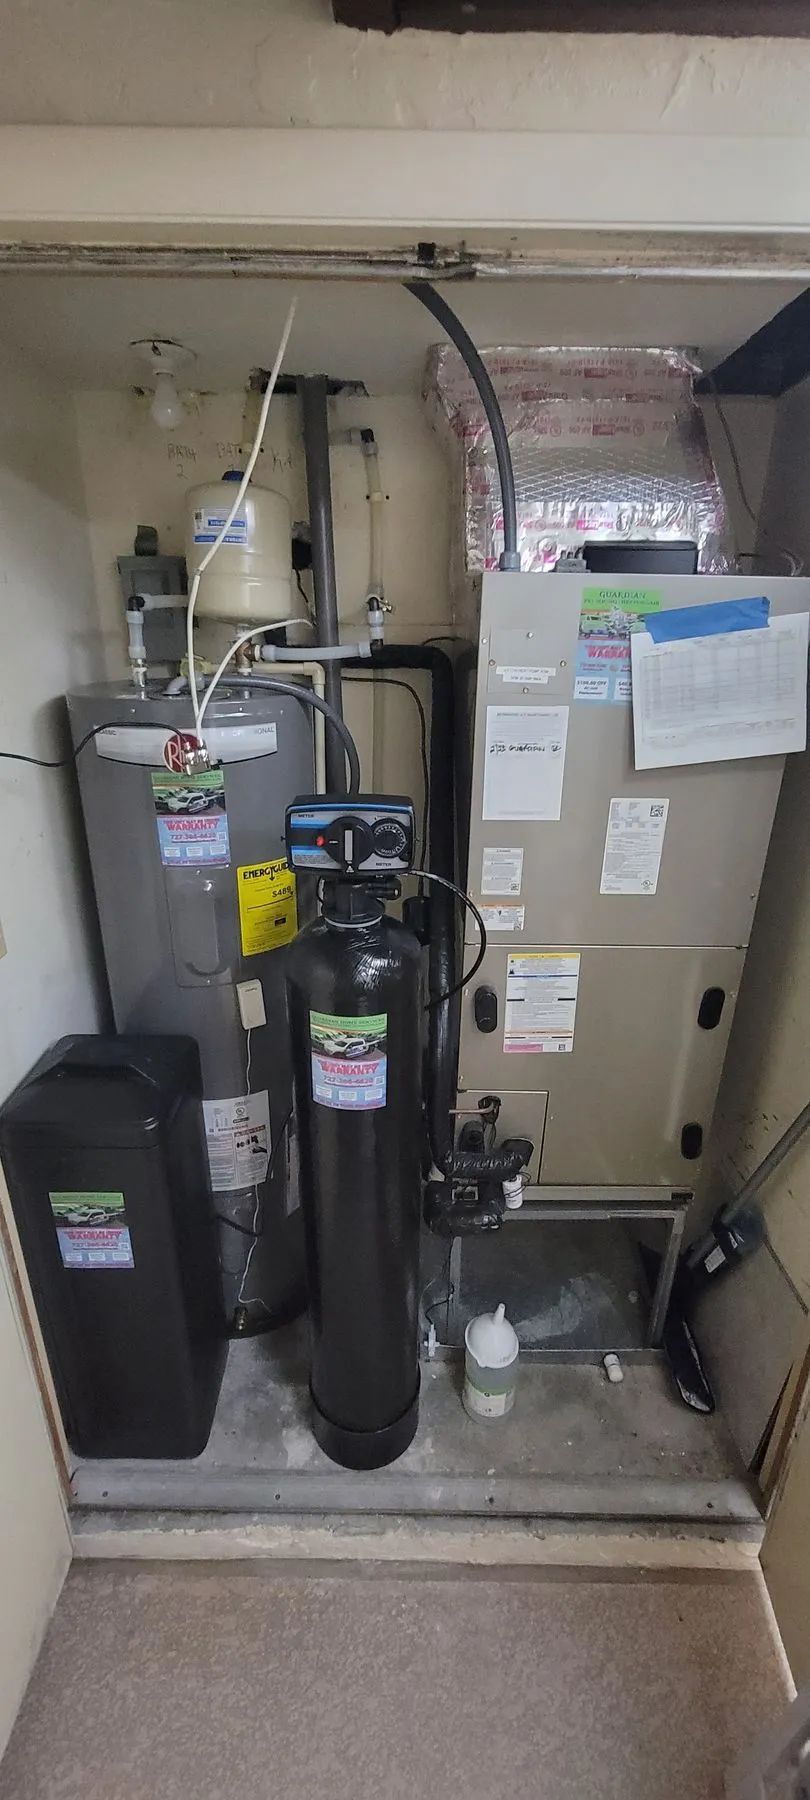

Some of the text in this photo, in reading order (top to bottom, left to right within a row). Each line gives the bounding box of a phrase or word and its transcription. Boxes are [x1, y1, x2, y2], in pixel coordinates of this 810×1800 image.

[599, 591, 647, 599] GUARDIAN
[166, 820, 218, 831] WARRANTY
[243, 861, 289, 880] ENERGYGUID
[321, 1063, 377, 1075] WARRANTY
